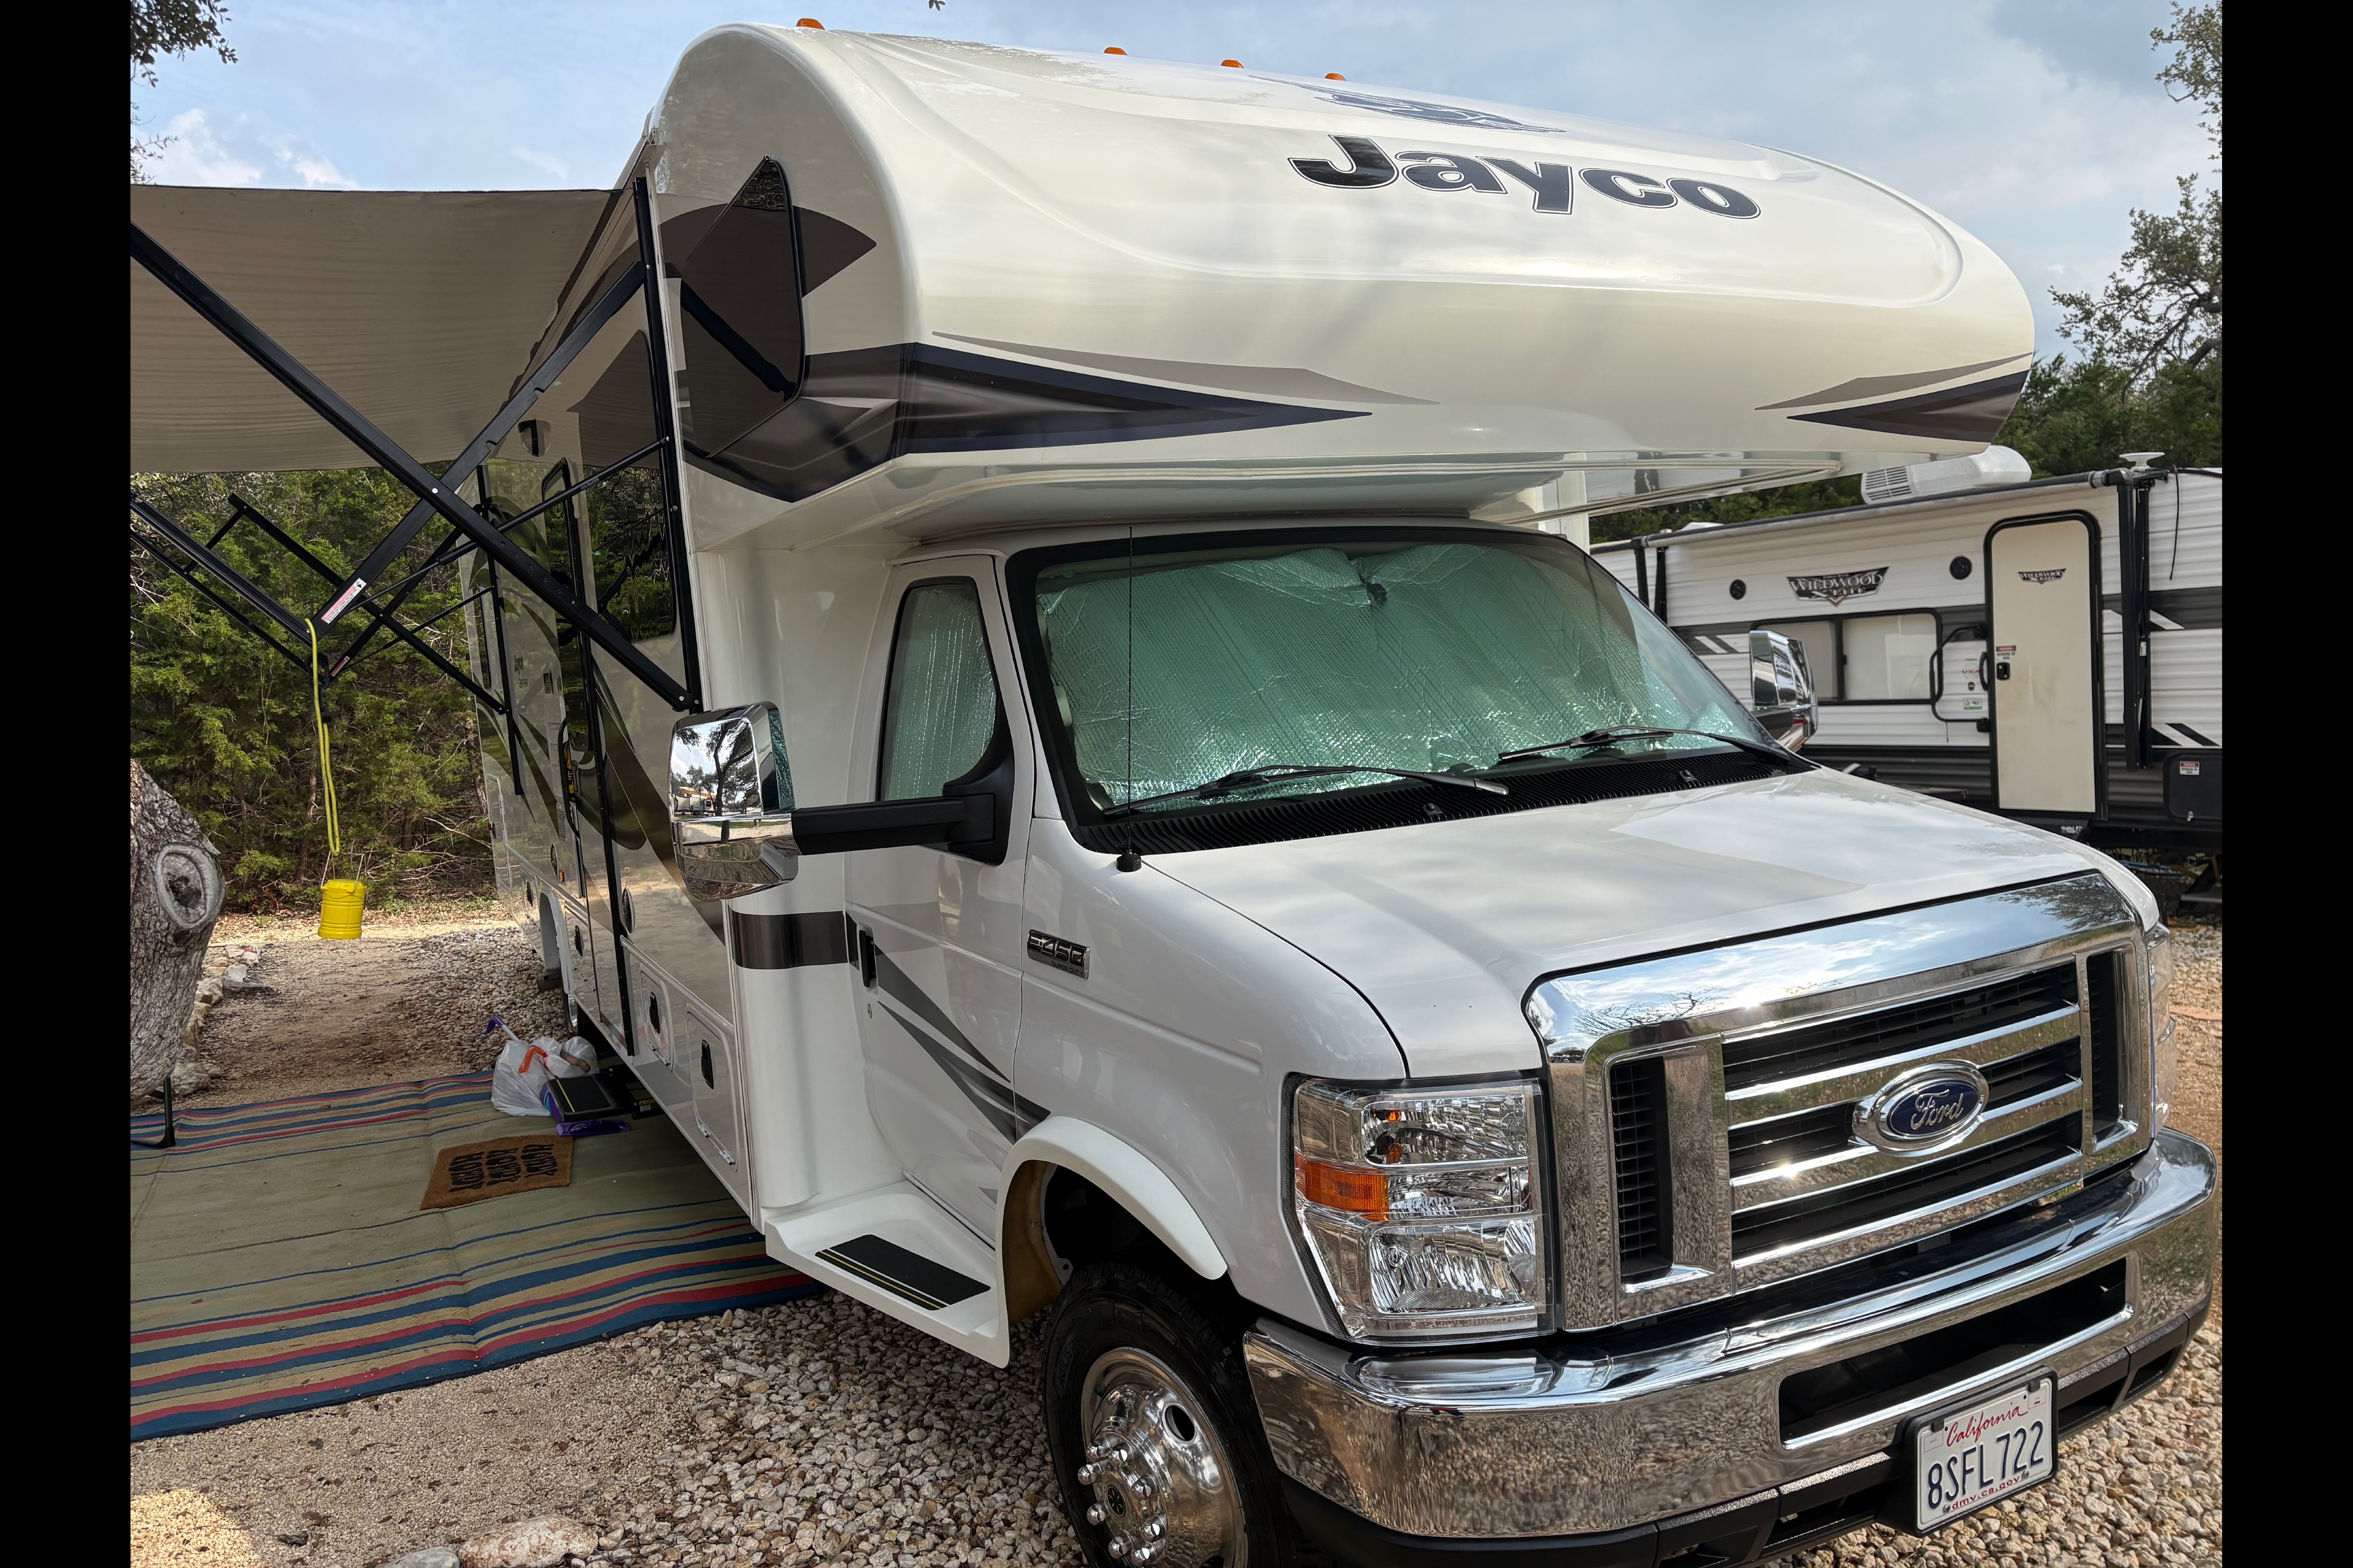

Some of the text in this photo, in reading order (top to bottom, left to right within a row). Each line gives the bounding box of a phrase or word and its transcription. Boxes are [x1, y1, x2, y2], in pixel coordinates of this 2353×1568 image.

[1288, 134, 1761, 219] Jayco
[1791, 574, 1883, 591] WILDWOOD
[514, 654, 524, 675] Jayco
[1051, 961, 1083, 977] SUPER DUTY
[1910, 1089, 1964, 1130] Ford
[520, 1143, 558, 1178] HOWDY
[1947, 1406, 2028, 1447] California
[1928, 1420, 2044, 1509] 8SFL 722
[1952, 1475, 2020, 1510] dmv.ca.gov
